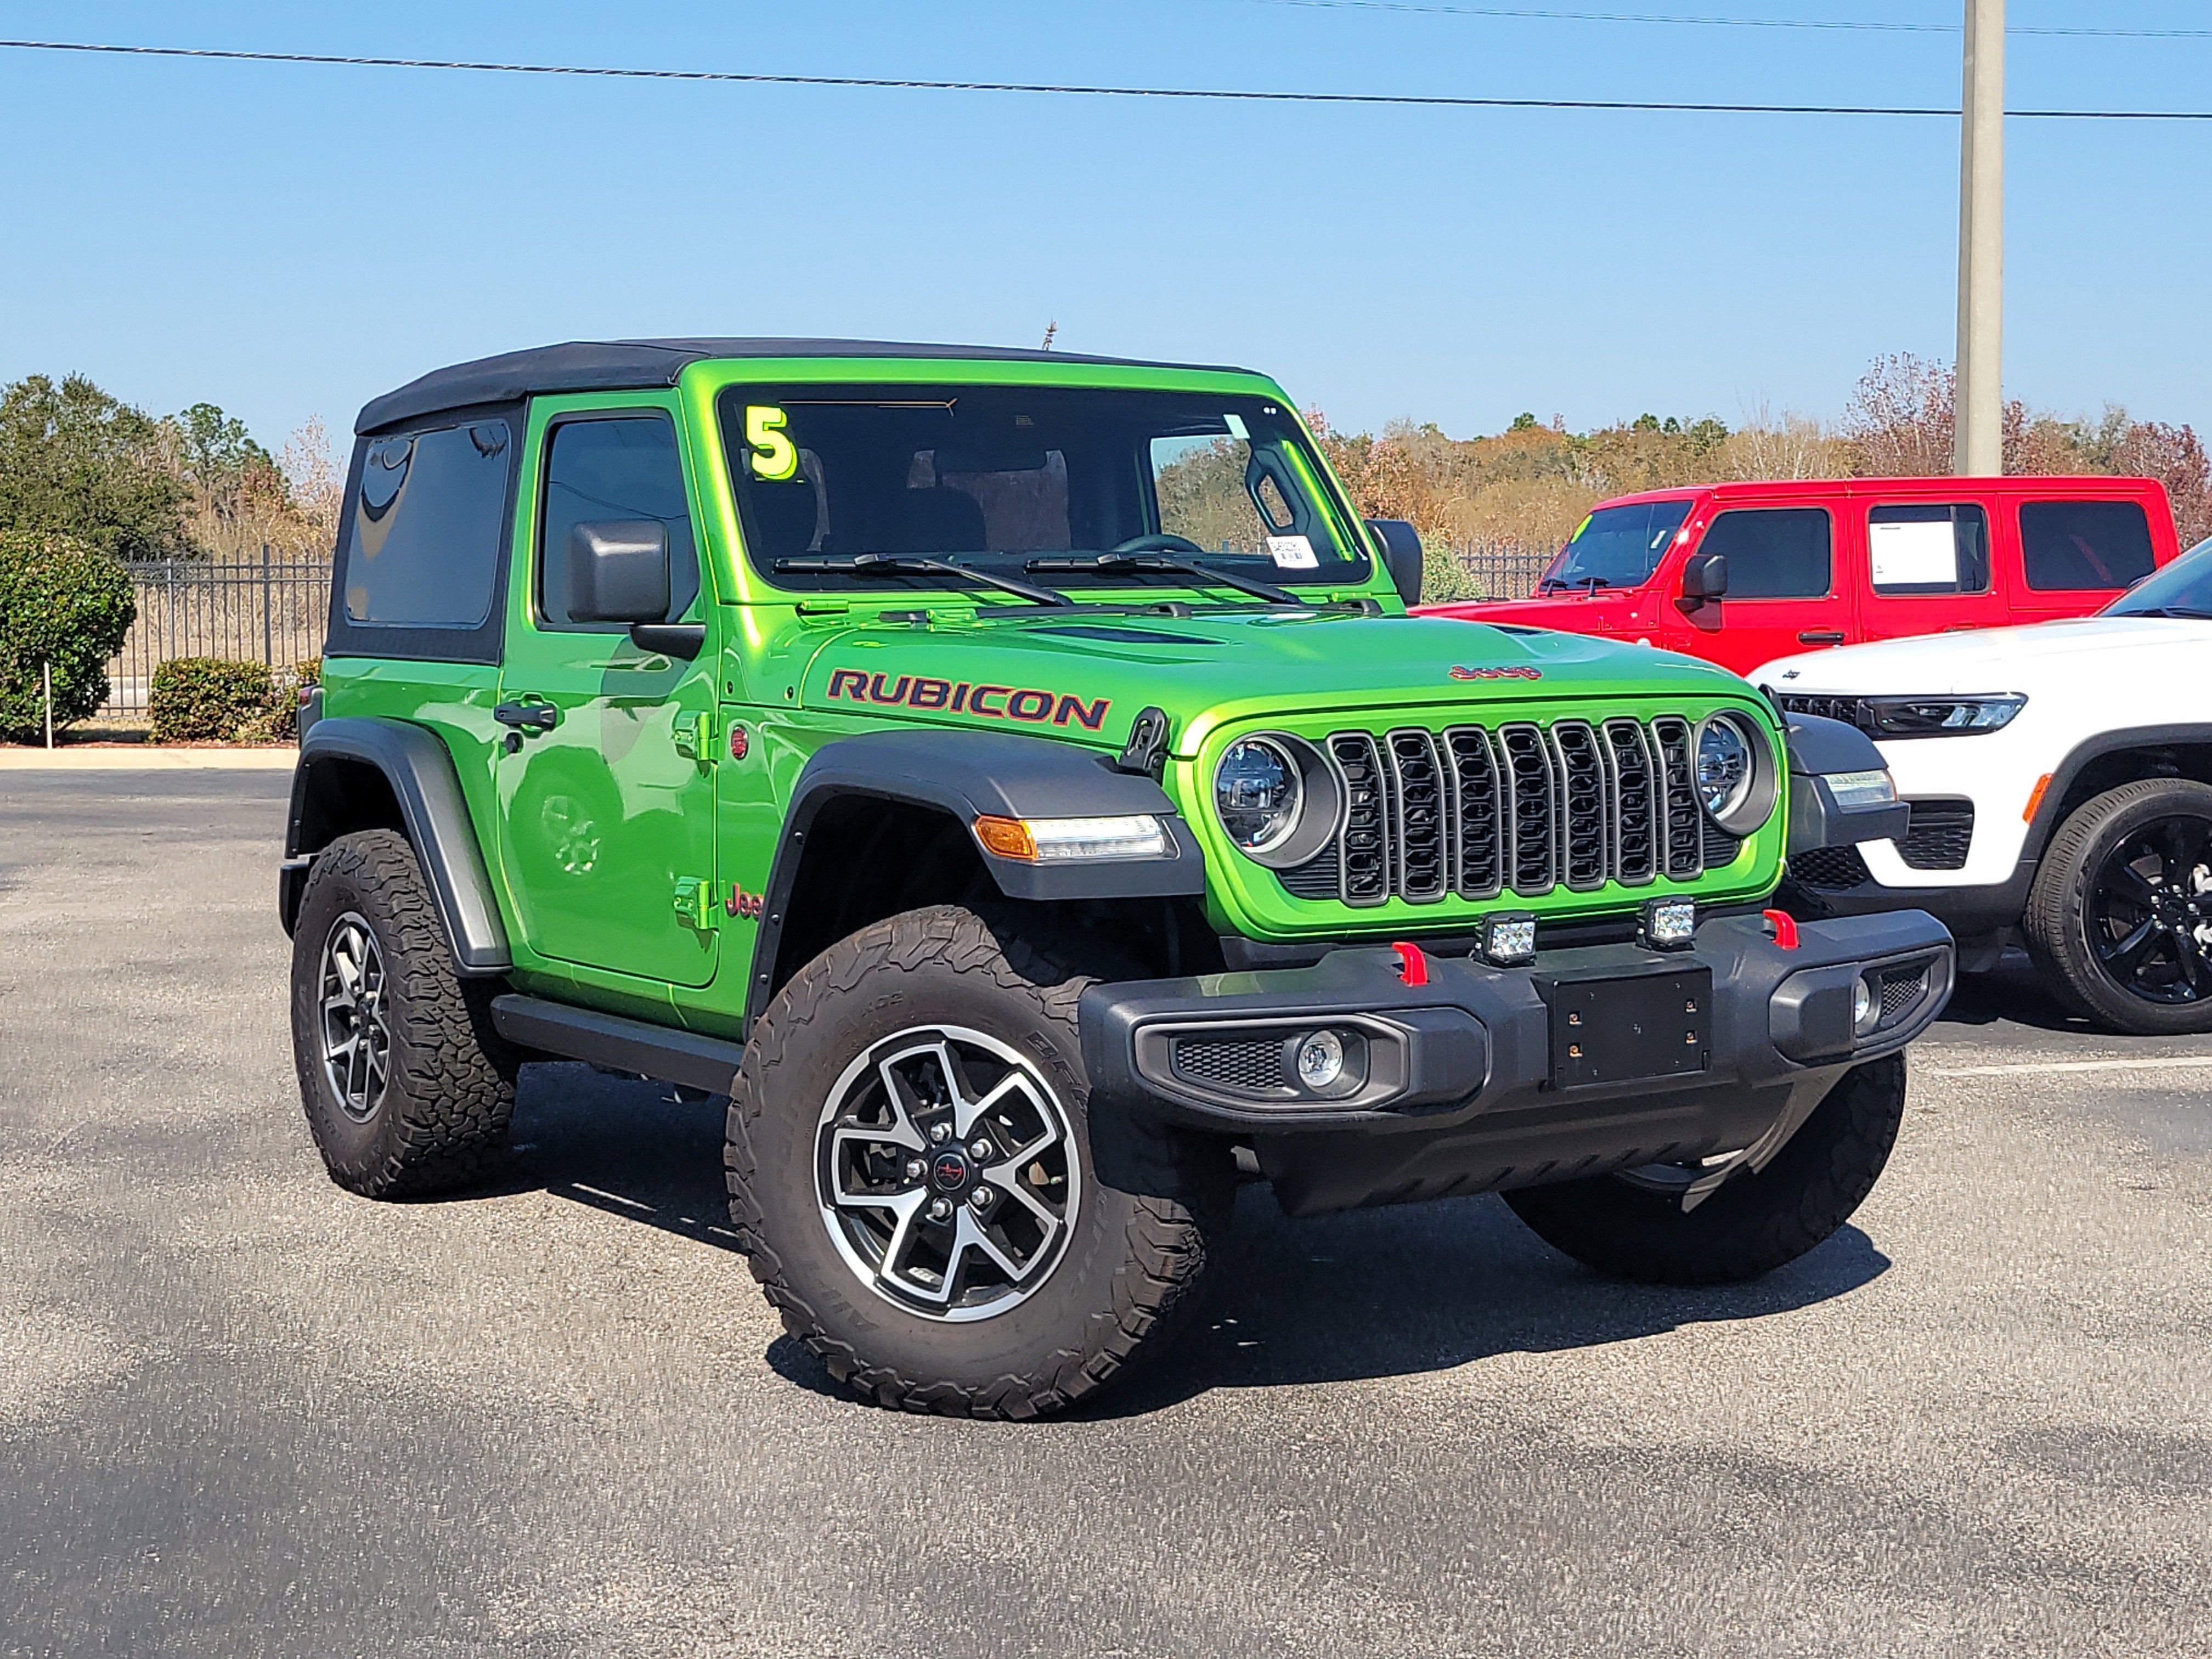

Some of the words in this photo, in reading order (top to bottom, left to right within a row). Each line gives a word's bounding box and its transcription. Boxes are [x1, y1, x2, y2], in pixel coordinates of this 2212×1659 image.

[746, 405, 798, 480] 5
[827, 668, 1112, 731] RUBICON
[725, 883, 764, 922] Jee
